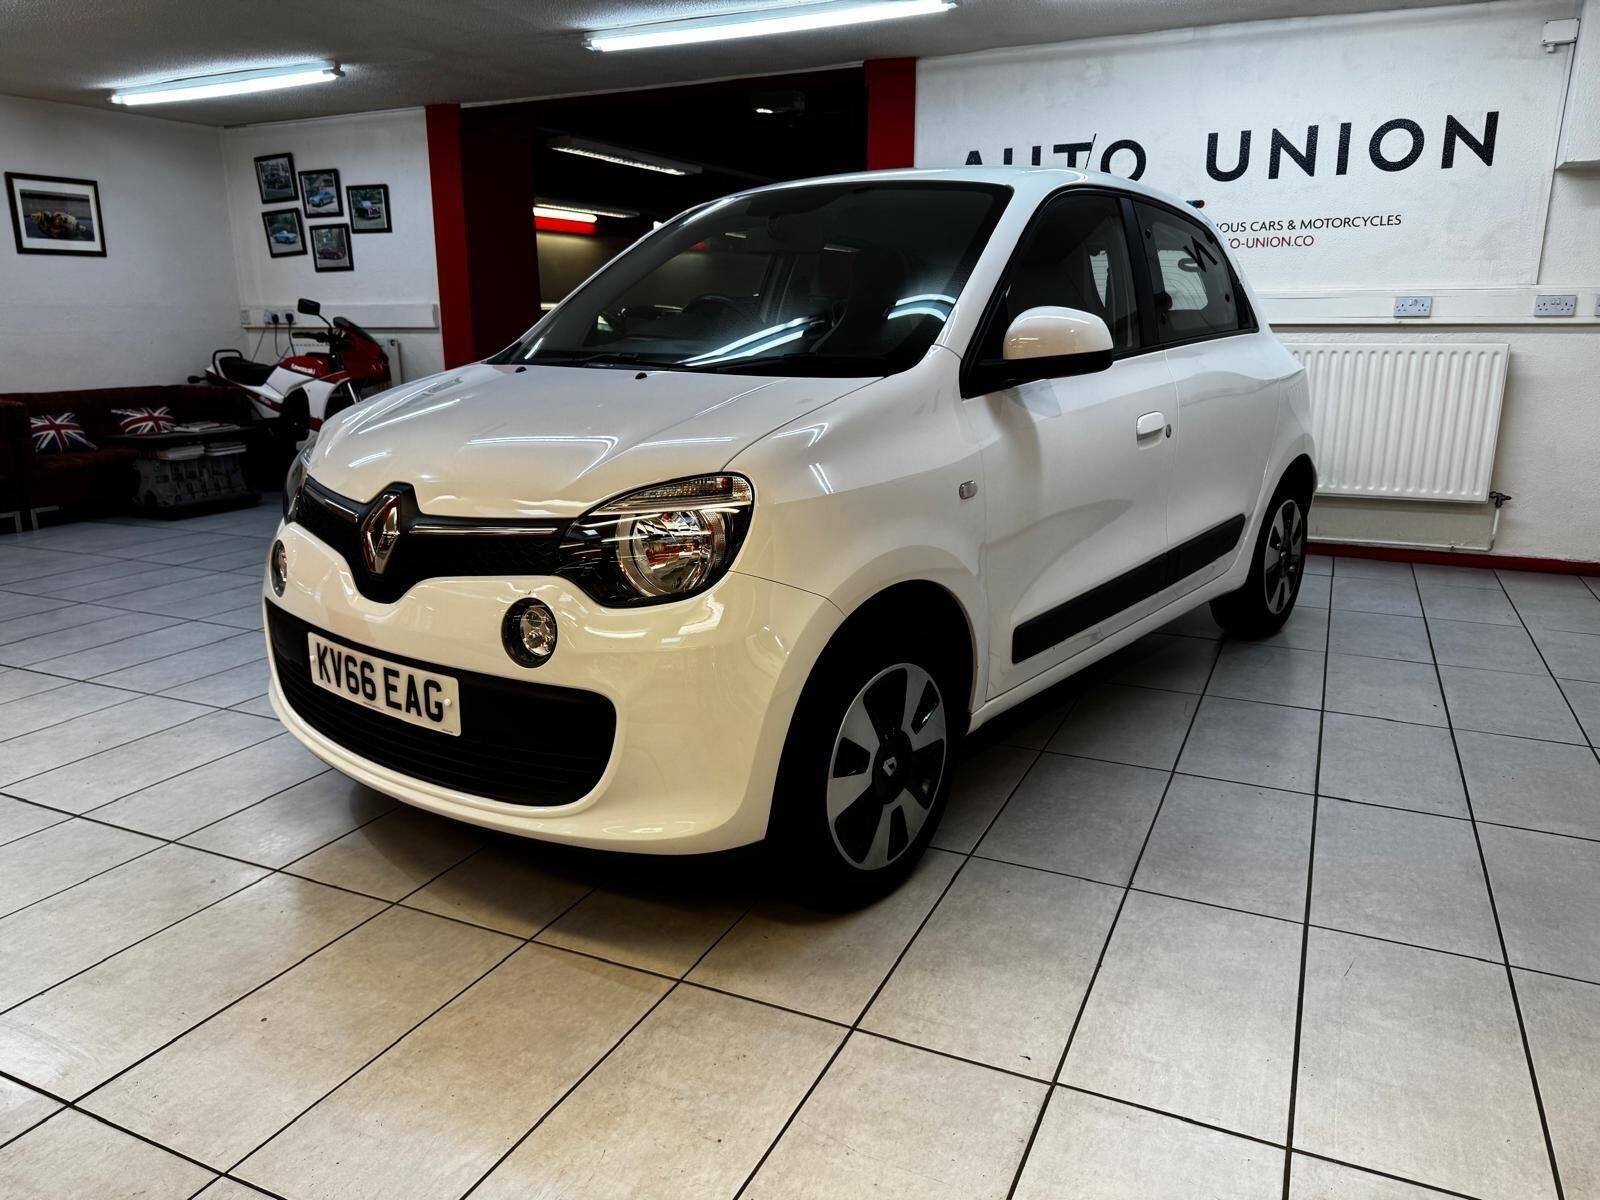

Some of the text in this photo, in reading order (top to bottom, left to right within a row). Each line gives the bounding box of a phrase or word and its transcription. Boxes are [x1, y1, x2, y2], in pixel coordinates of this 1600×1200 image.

[1206, 111, 1500, 182] UNION
[1228, 235, 1315, 249] O-UNION.CO
[1250, 220, 1284, 232] CARS
[1287, 219, 1296, 230] &
[1299, 214, 1402, 230] MOTORCYCLES
[316, 642, 444, 723] KV66 EAG
